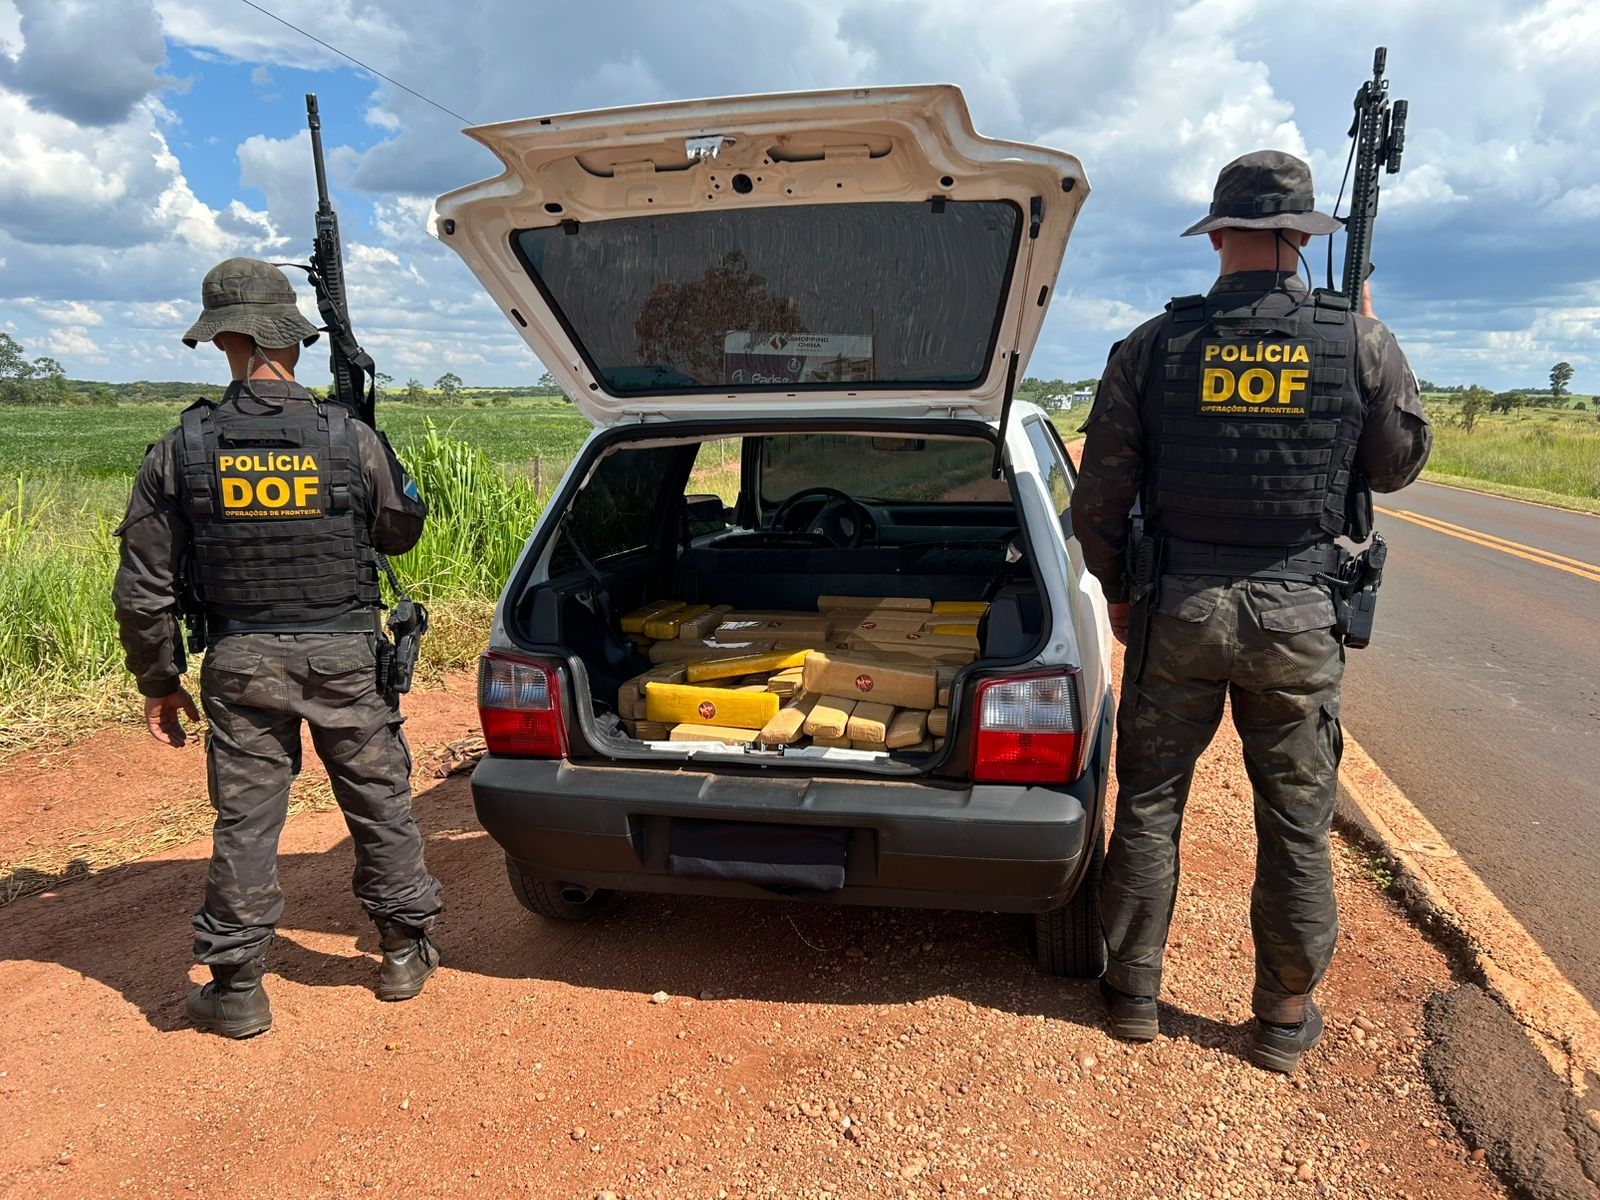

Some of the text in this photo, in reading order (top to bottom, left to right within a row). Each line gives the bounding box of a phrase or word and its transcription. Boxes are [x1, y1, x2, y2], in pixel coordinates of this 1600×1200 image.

[1205, 341, 1309, 362] POLÍCIA
[1202, 368, 1309, 403] DOF
[1201, 405, 1247, 413] OPERAÇÕES
[1260, 406, 1305, 414] FRONTEIRA
[219, 451, 318, 472] POLÍCIA
[221, 477, 319, 508] DOF
[225, 509, 267, 517] OPERAÇÕES
[281, 508, 321, 516] FRONTEIRA
